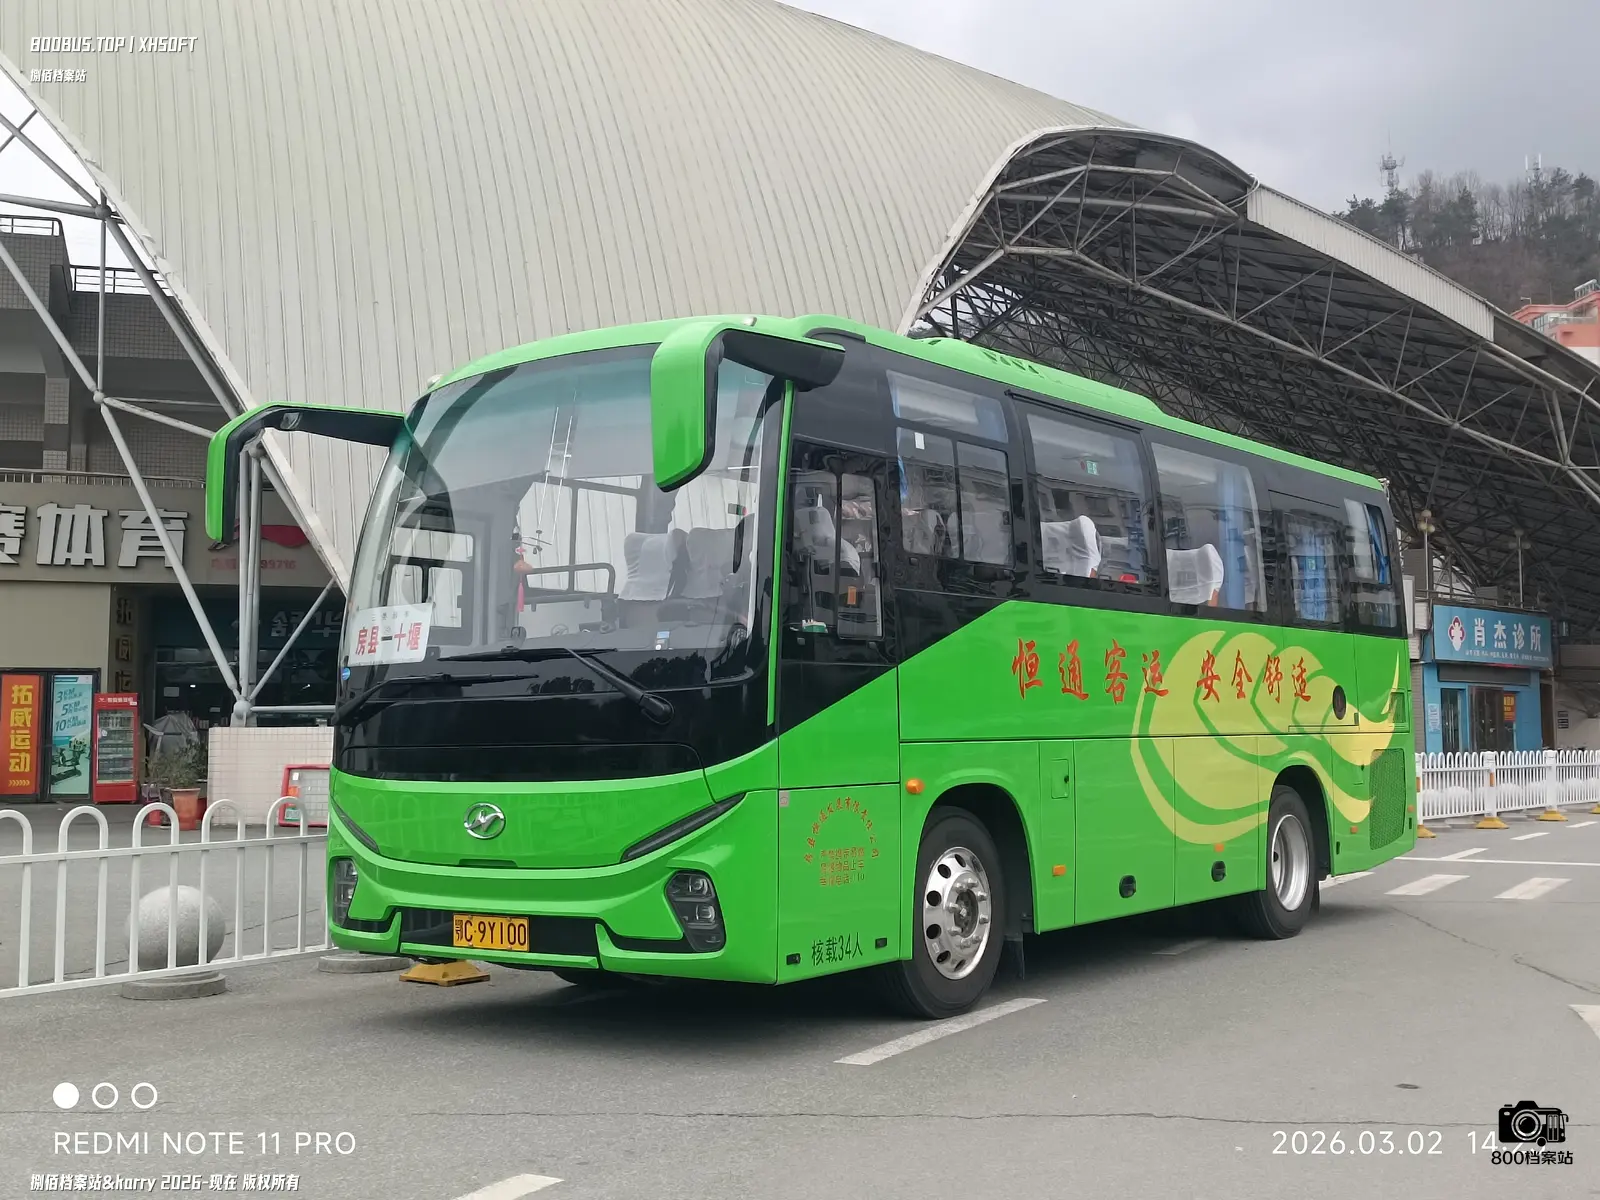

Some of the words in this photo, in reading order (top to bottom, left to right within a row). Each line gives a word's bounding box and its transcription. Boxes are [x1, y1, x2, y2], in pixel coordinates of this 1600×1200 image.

[1473, 617, 1542, 652] 肖杰诊所
[1012, 638, 1169, 704] 恒通客运
[1196, 649, 1312, 704] 安全舒适
[8, 684, 33, 773] 拓威运动
[812, 931, 863, 967] 核载34人
